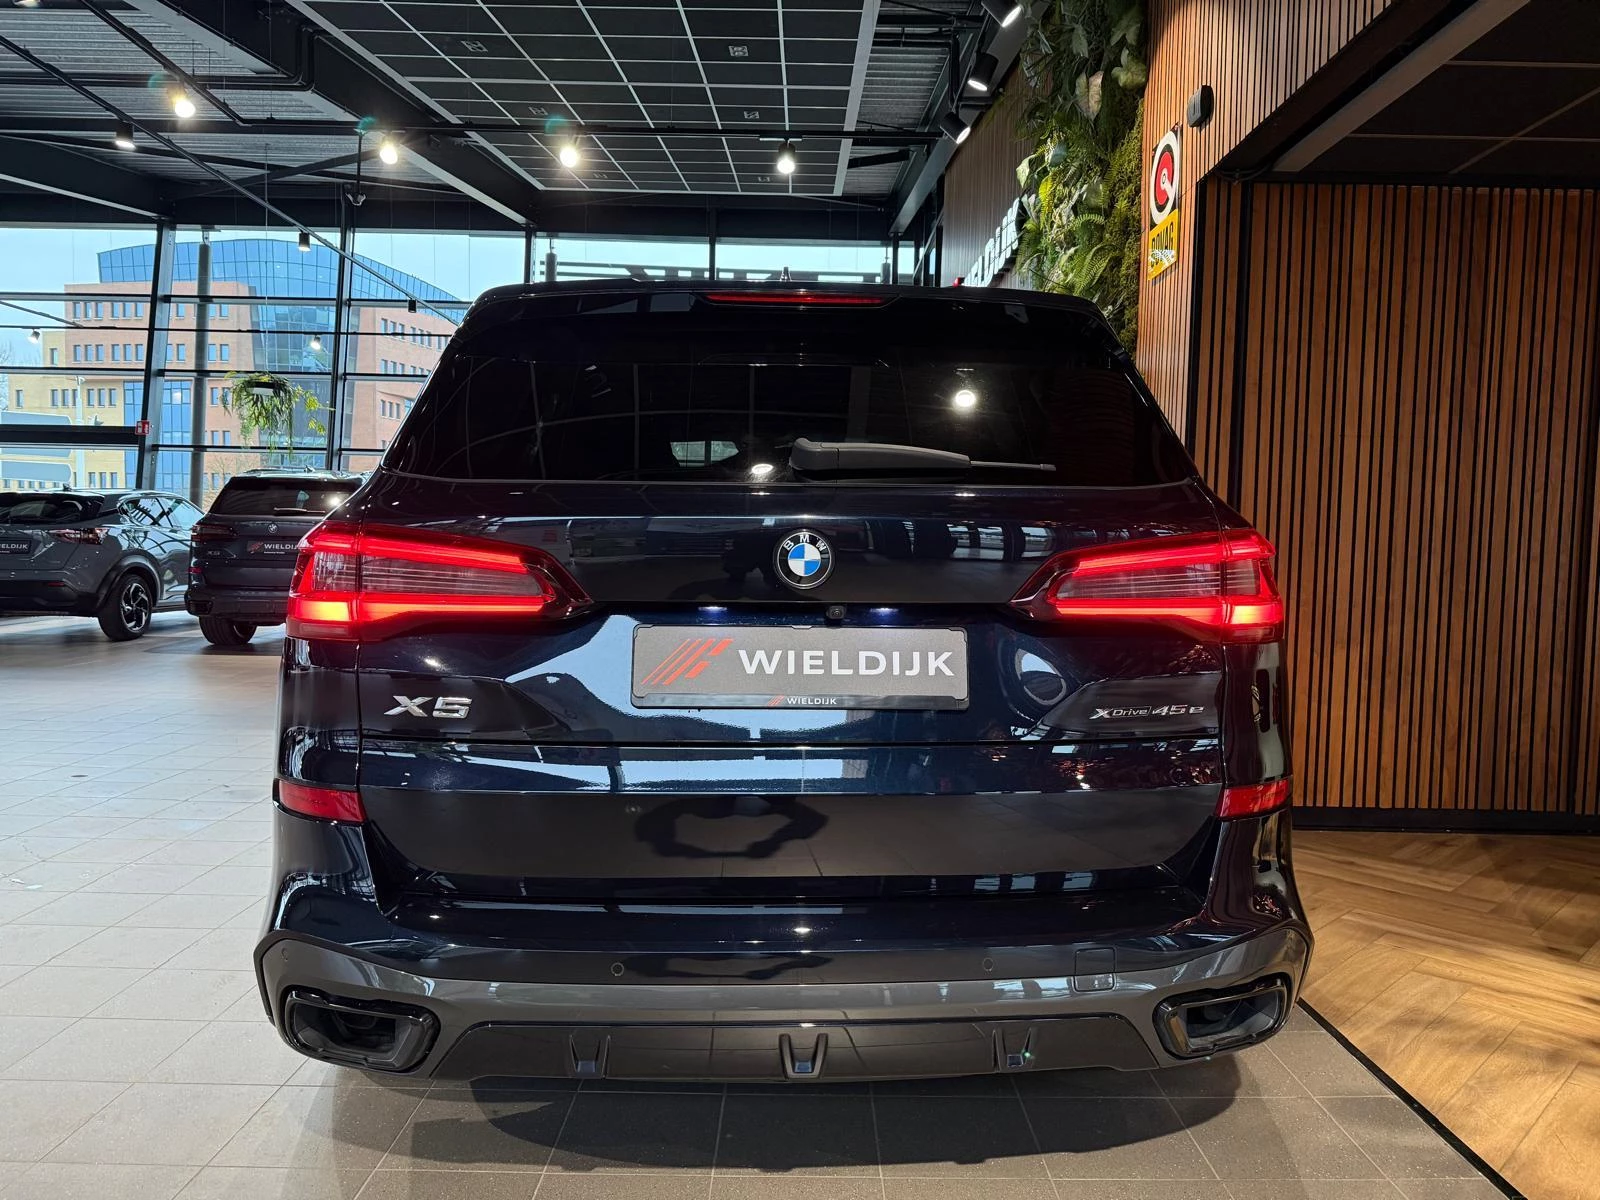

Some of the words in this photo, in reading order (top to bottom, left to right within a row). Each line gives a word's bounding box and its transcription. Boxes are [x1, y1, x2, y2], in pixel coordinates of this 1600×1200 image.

[263, 543, 298, 551] WIELDIJ
[738, 649, 955, 677] WIELDIJK
[383, 695, 473, 719] X5
[786, 695, 838, 706] WIELDIJK
